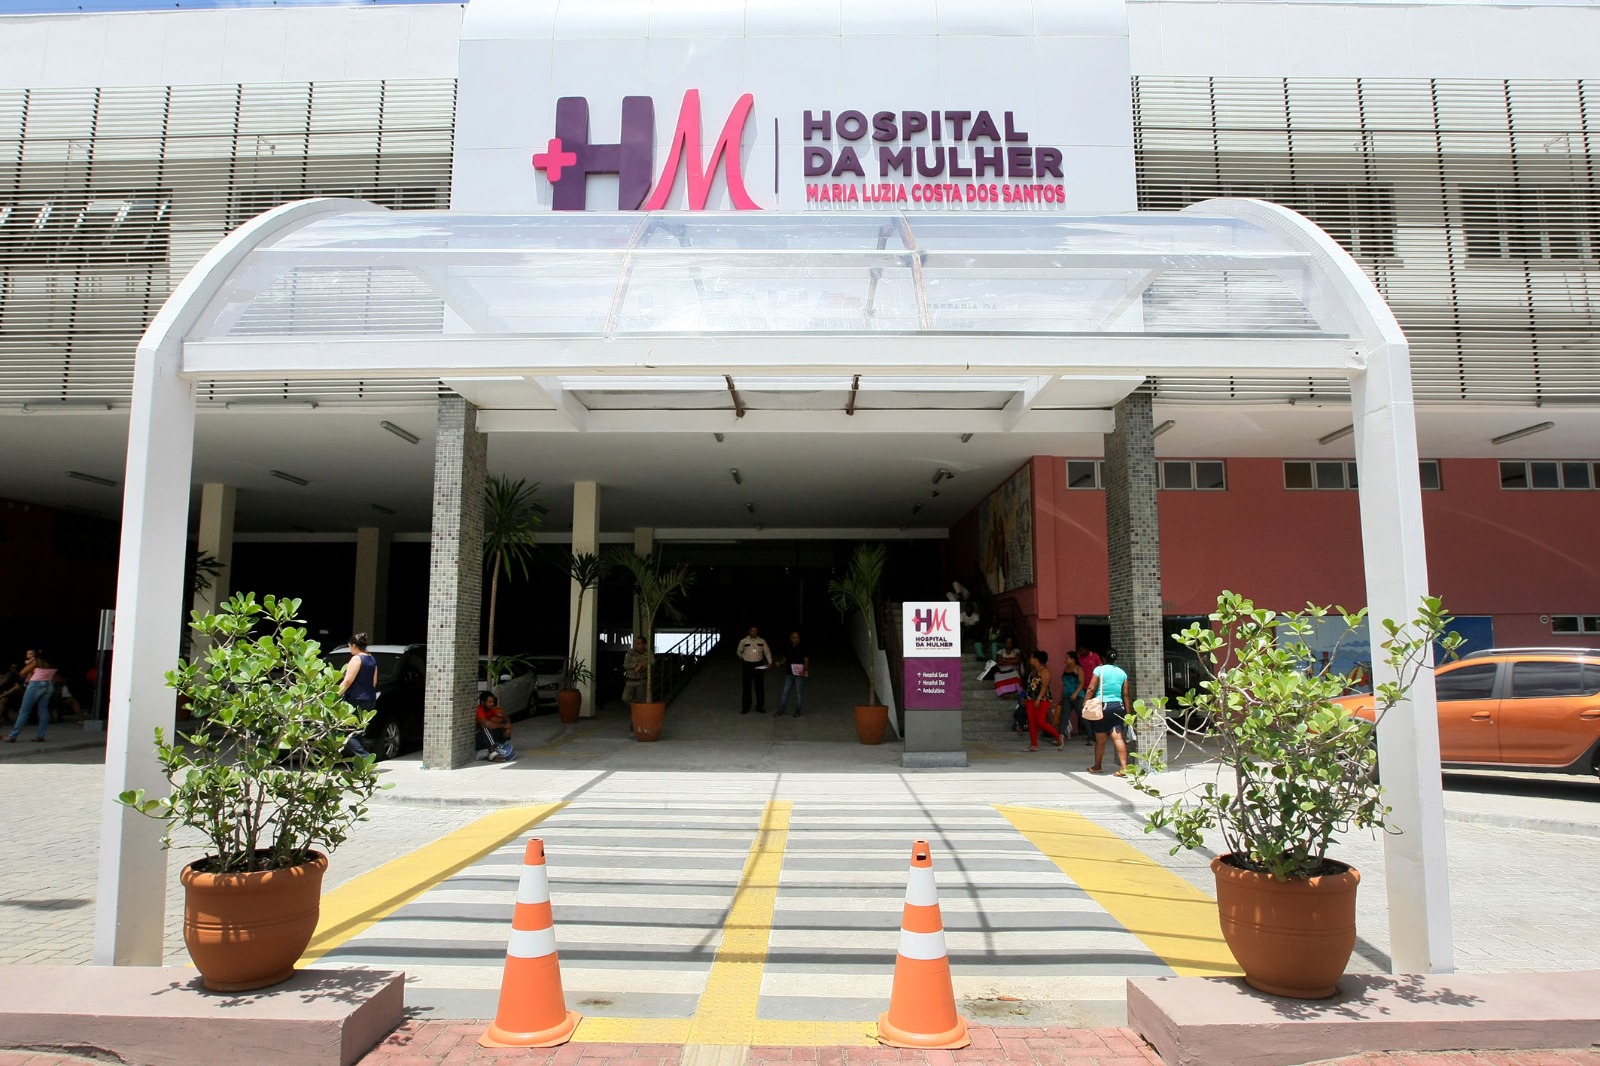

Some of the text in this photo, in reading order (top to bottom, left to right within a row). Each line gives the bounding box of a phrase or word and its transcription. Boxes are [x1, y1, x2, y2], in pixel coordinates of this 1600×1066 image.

[803, 110, 1029, 141] HOSPITAL
[552, 89, 764, 210] HM
[804, 146, 1064, 177] DA MULHER
[806, 183, 1066, 203] MARIA LUZIA COSTA DOS SANTOS
